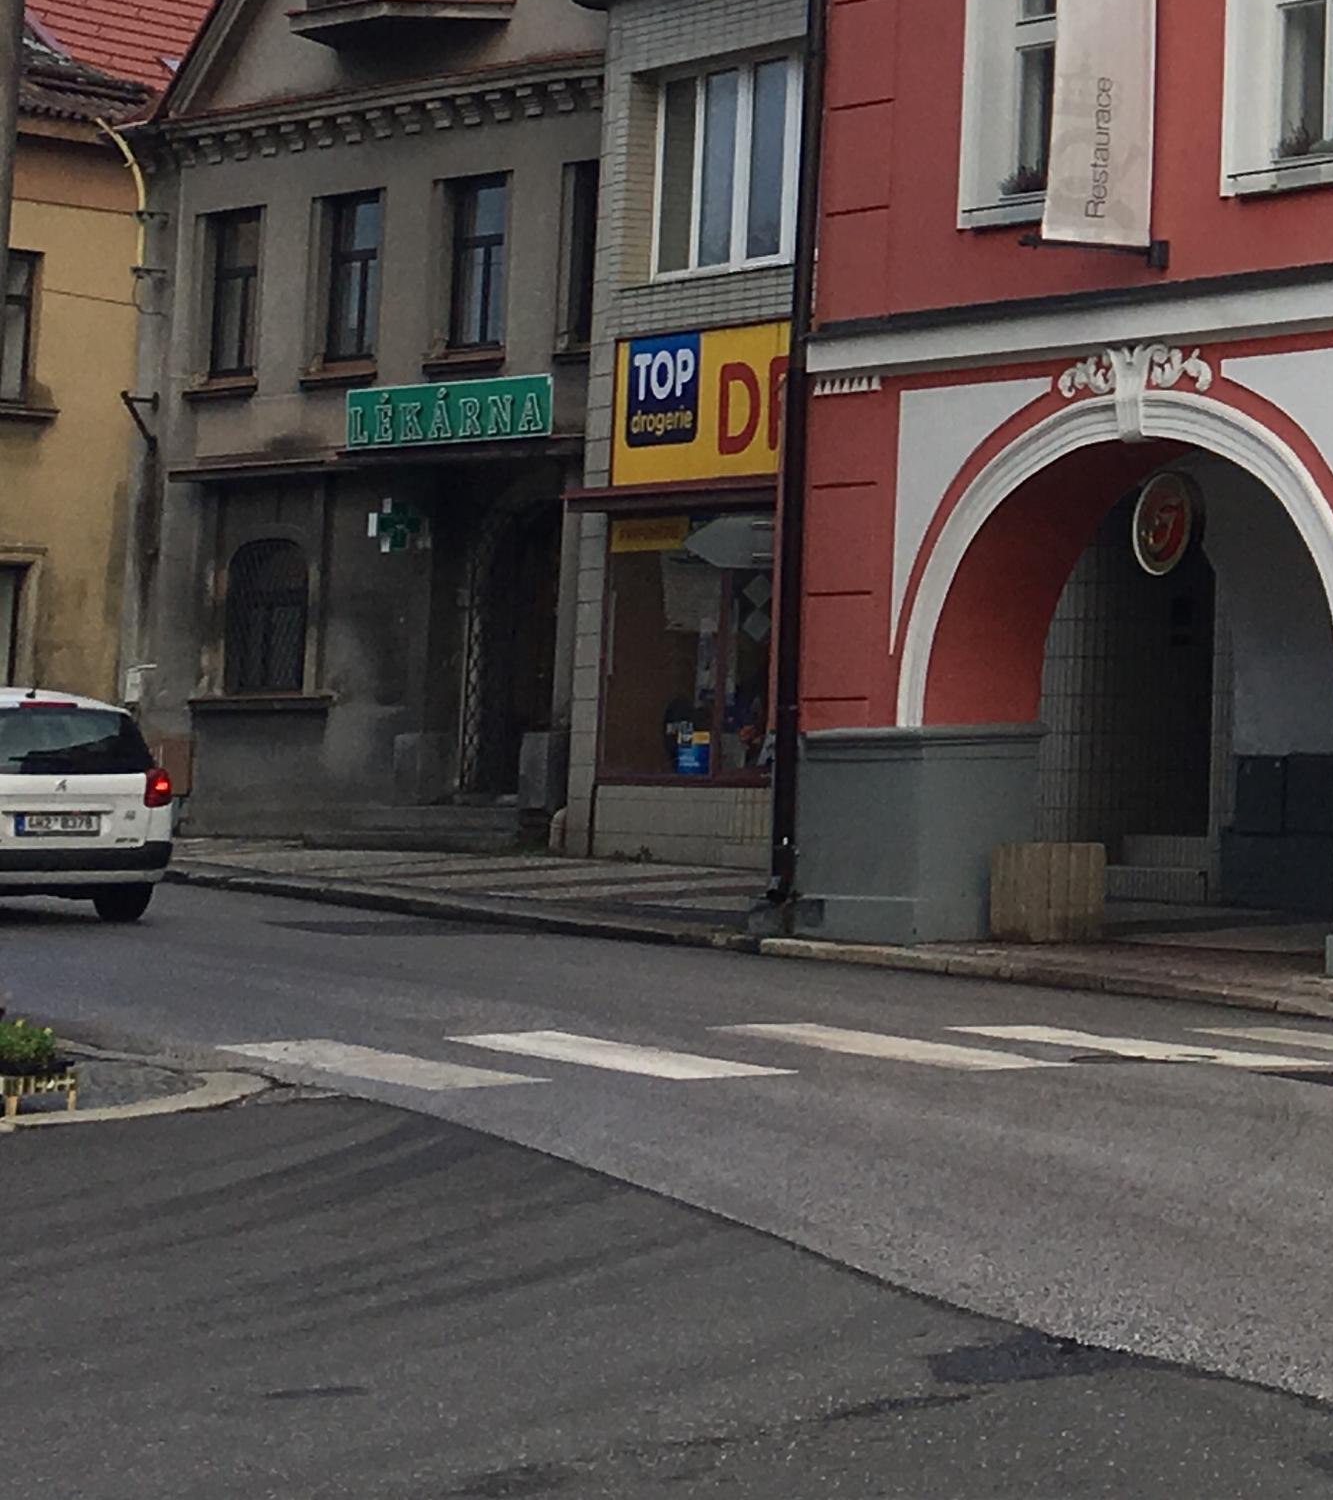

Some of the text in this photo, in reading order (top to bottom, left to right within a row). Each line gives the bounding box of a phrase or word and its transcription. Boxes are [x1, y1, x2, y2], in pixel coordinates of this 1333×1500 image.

[1084, 76, 1114, 219] Restaurace
[633, 348, 695, 402] TOP
[347, 387, 544, 445] LÉKÁRNA
[630, 404, 694, 434] drogerie
